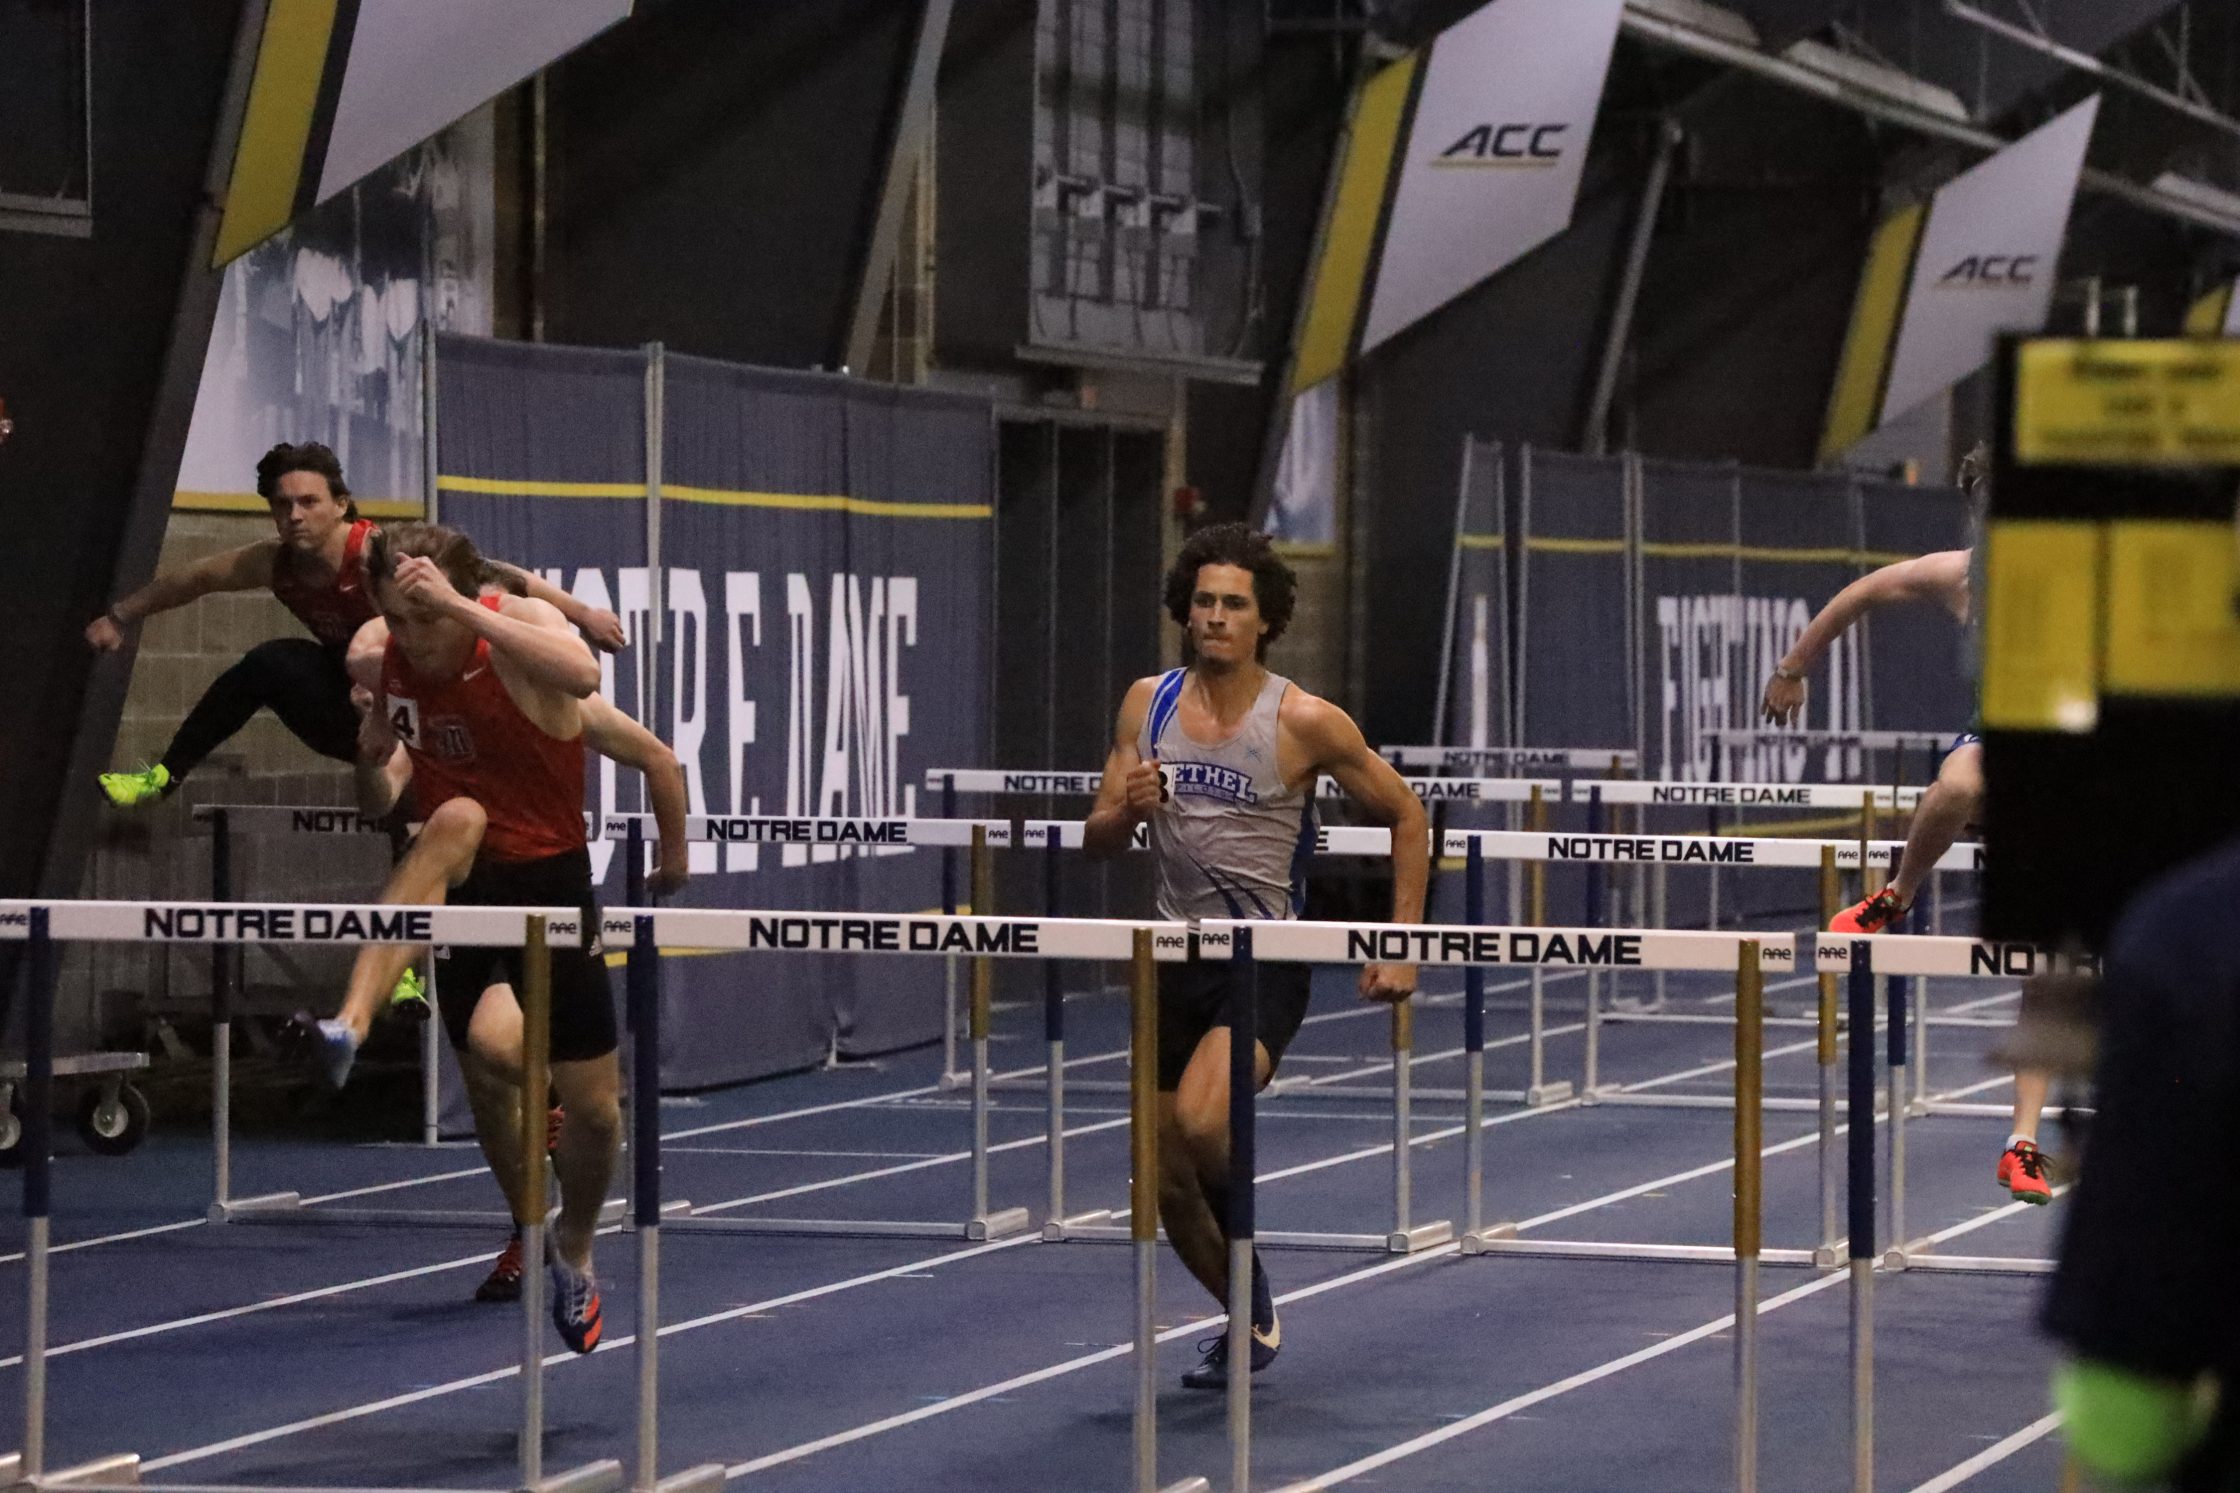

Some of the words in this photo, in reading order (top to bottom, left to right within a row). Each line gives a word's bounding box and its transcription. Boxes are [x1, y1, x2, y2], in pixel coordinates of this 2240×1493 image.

[1441, 123, 1569, 157] ACC
[1941, 255, 2038, 281] ACC
[391, 705, 415, 740] 4
[533, 567, 760, 885] OTRE
[782, 573, 918, 867] DAME
[1513, 752, 1570, 766] DAME
[1004, 775, 1083, 793] NOTRE
[1175, 764, 1255, 803] ETHEL
[1412, 782, 1480, 800] DAME
[1653, 786, 1734, 804] NOTRE
[1741, 788, 1811, 805] DAME
[706, 819, 811, 841] NOTRE
[818, 822, 907, 842] DAME
[1549, 837, 1655, 860] NOTRE
[1661, 840, 1754, 862] DAME
[145, 907, 295, 938] NOTRE
[304, 910, 432, 940] DAME
[750, 917, 900, 950] NOTRE
[909, 920, 1039, 953] DAME
[1348, 929, 1500, 962] NOTRE
[1509, 932, 1642, 965] DAME
